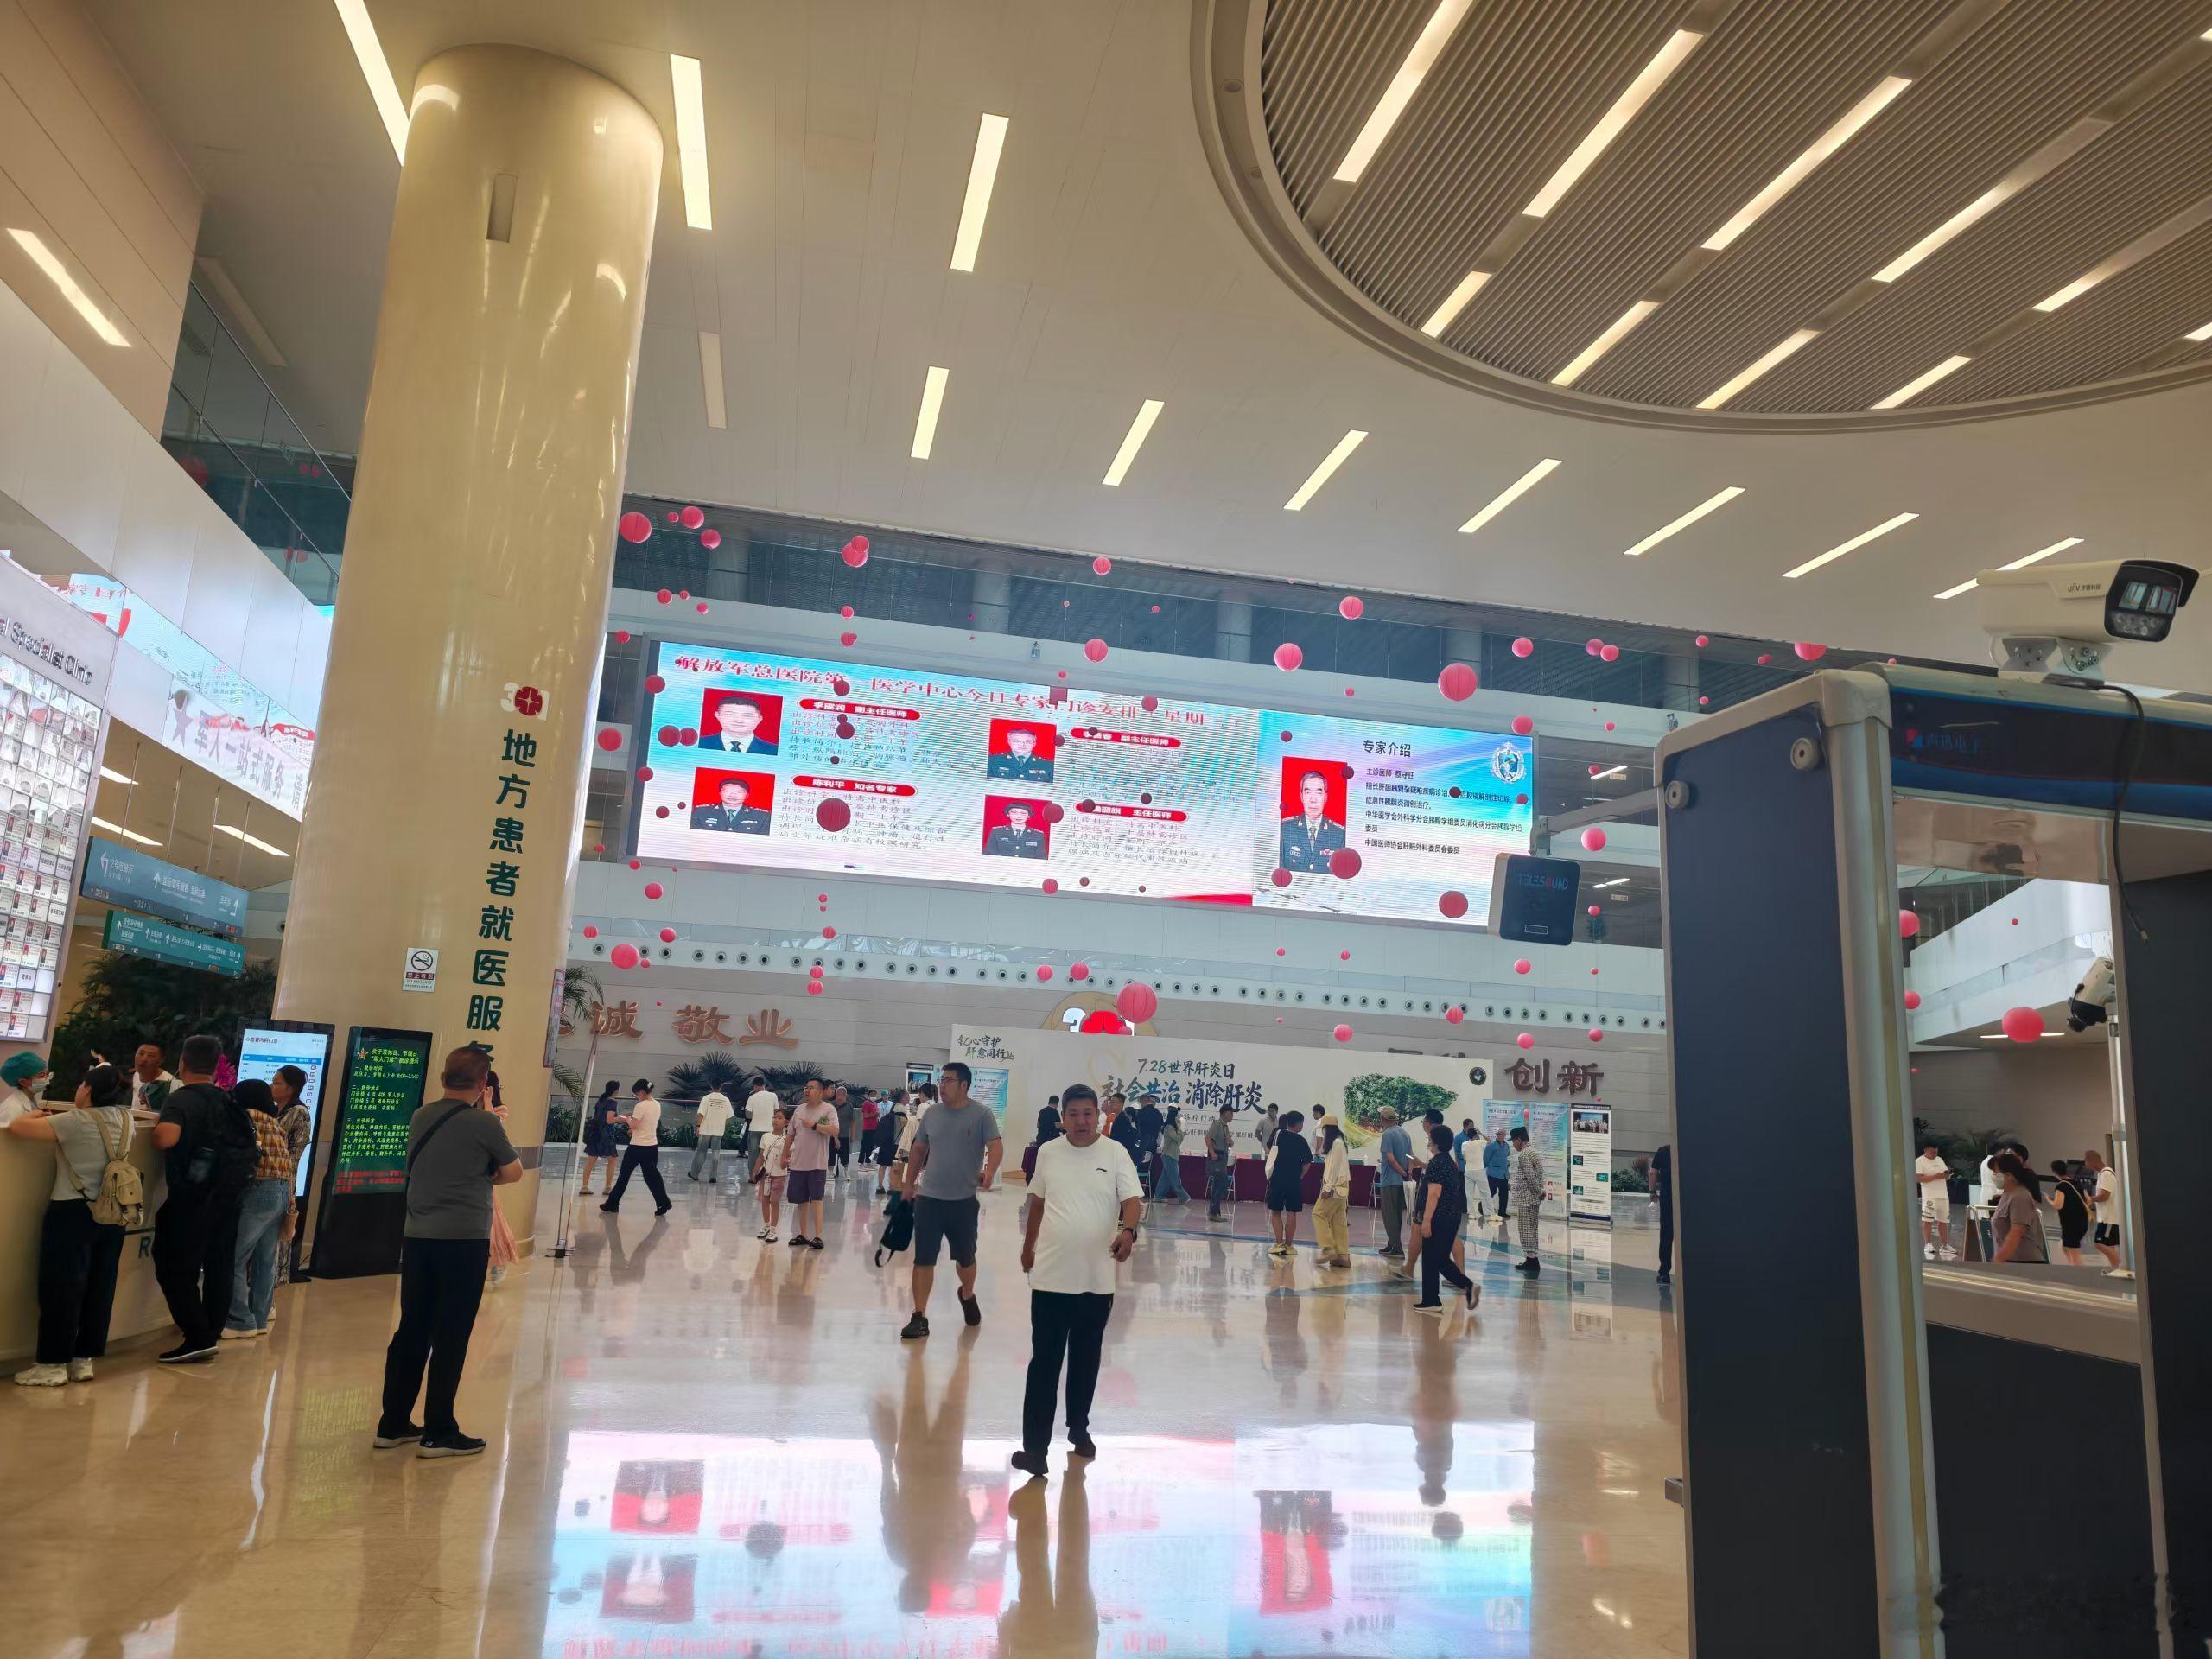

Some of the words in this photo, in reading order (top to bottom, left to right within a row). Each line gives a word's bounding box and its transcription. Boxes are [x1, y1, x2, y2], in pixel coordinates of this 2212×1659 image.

[11, 622, 64, 670] Specialist
[65, 656, 92, 685] Clinic
[1363, 739, 1411, 758] 专家介绍
[1503, 1057, 1605, 1096] 创新
[1185, 1078, 1270, 1115] 消除肝炎
